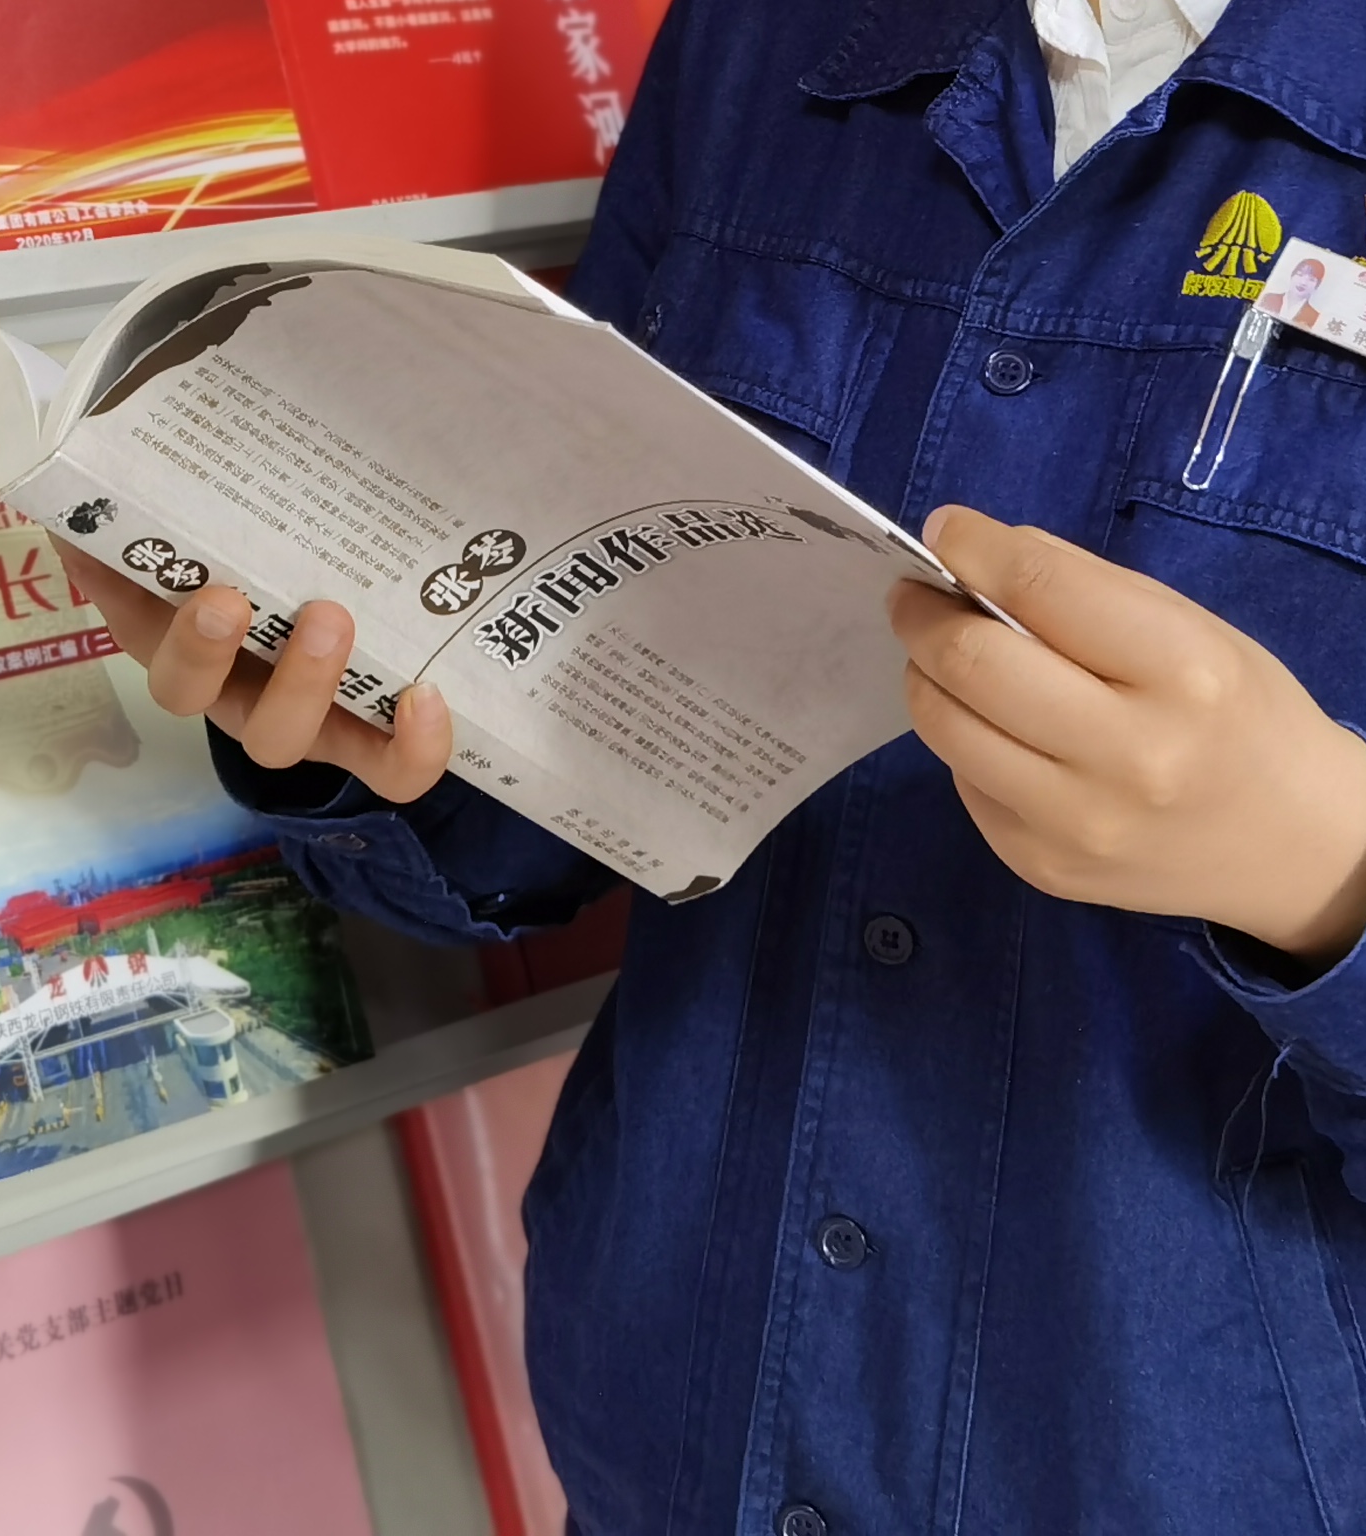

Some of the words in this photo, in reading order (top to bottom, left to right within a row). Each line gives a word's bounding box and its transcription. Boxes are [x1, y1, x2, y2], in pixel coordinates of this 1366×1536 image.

[16, 228, 95, 249] 2020年12月
[478, 507, 807, 668] 新闻作品选
